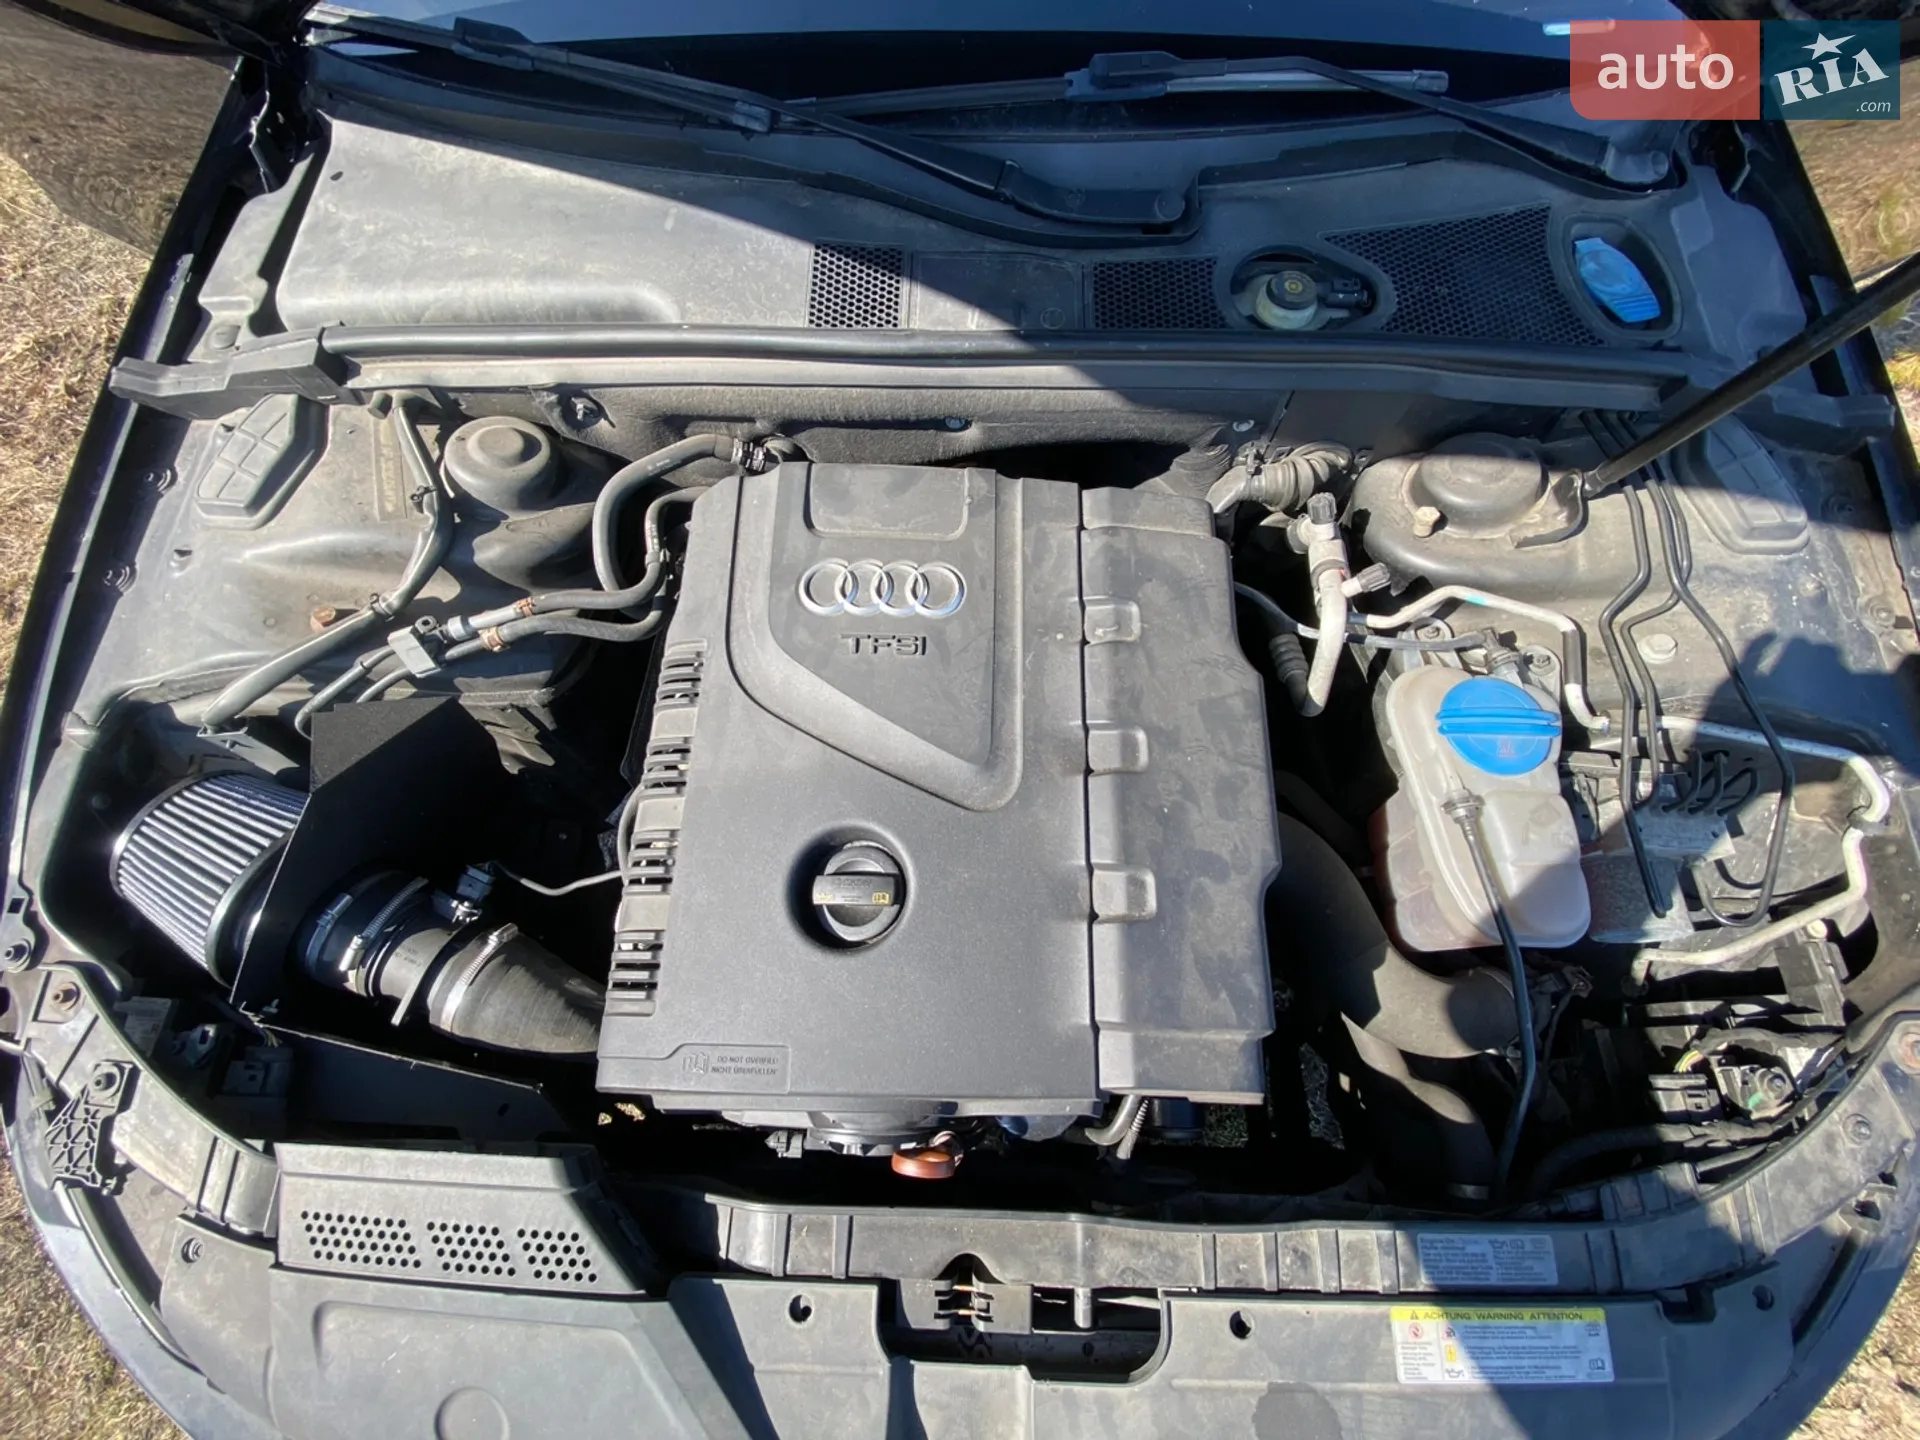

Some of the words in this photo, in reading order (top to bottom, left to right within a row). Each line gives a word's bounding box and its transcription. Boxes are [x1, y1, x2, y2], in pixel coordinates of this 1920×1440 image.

[841, 633, 927, 656] TFSI
[1423, 1311, 1471, 1320] ACHTUNG
[1475, 1311, 1524, 1320] WARNING
[1529, 1311, 1583, 1320] ATTENTION
